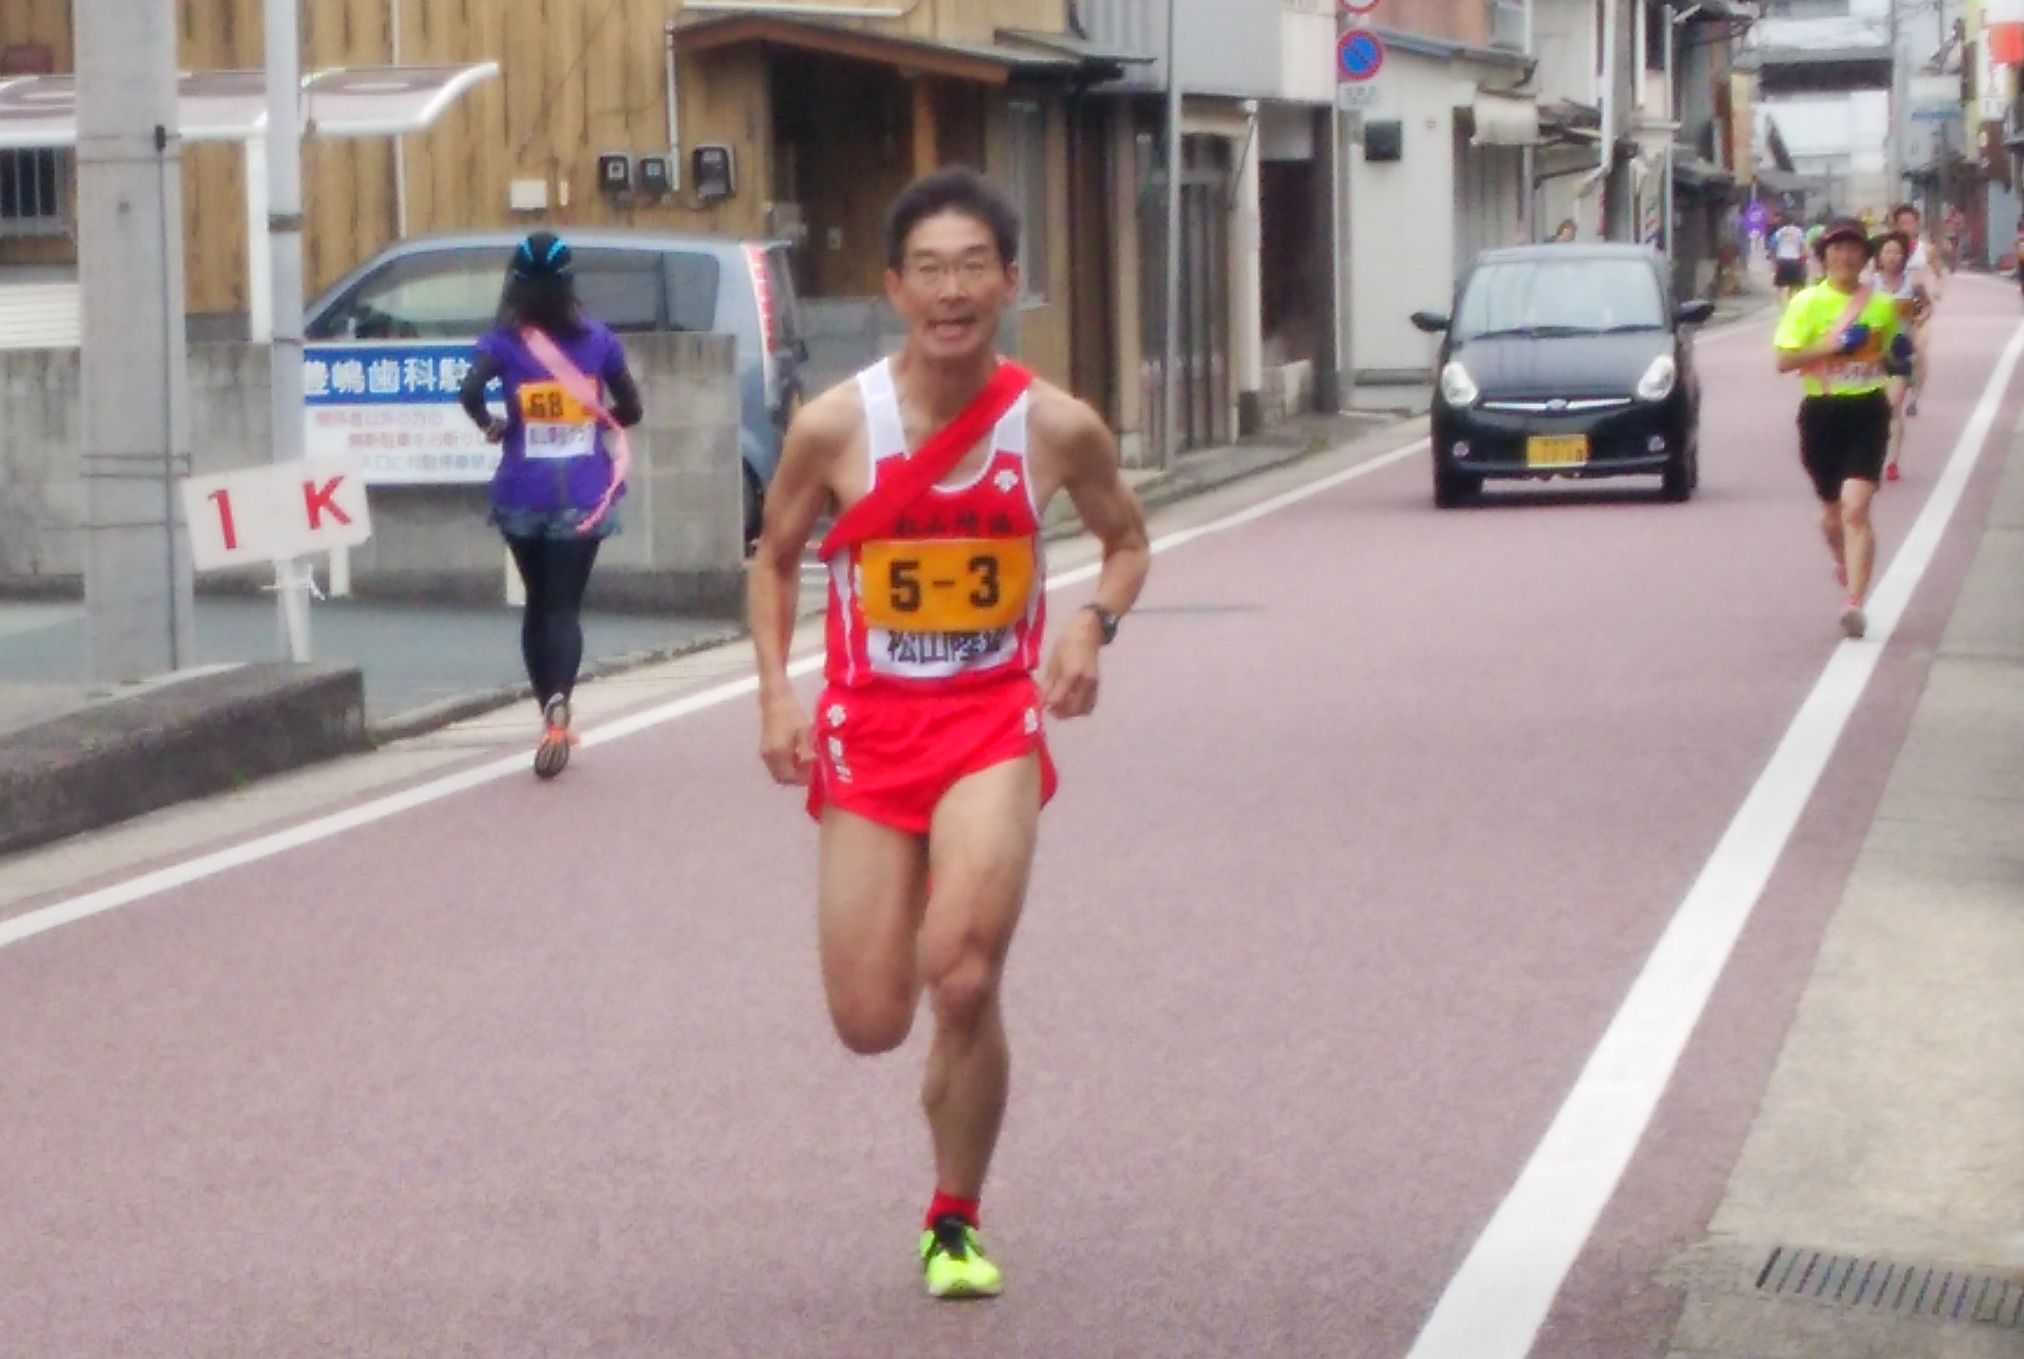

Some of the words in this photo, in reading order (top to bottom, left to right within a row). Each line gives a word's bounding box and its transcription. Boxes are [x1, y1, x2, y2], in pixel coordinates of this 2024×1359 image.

[208, 489, 237, 550] 1
[303, 475, 352, 530] K
[889, 555, 1000, 613] 5-3
